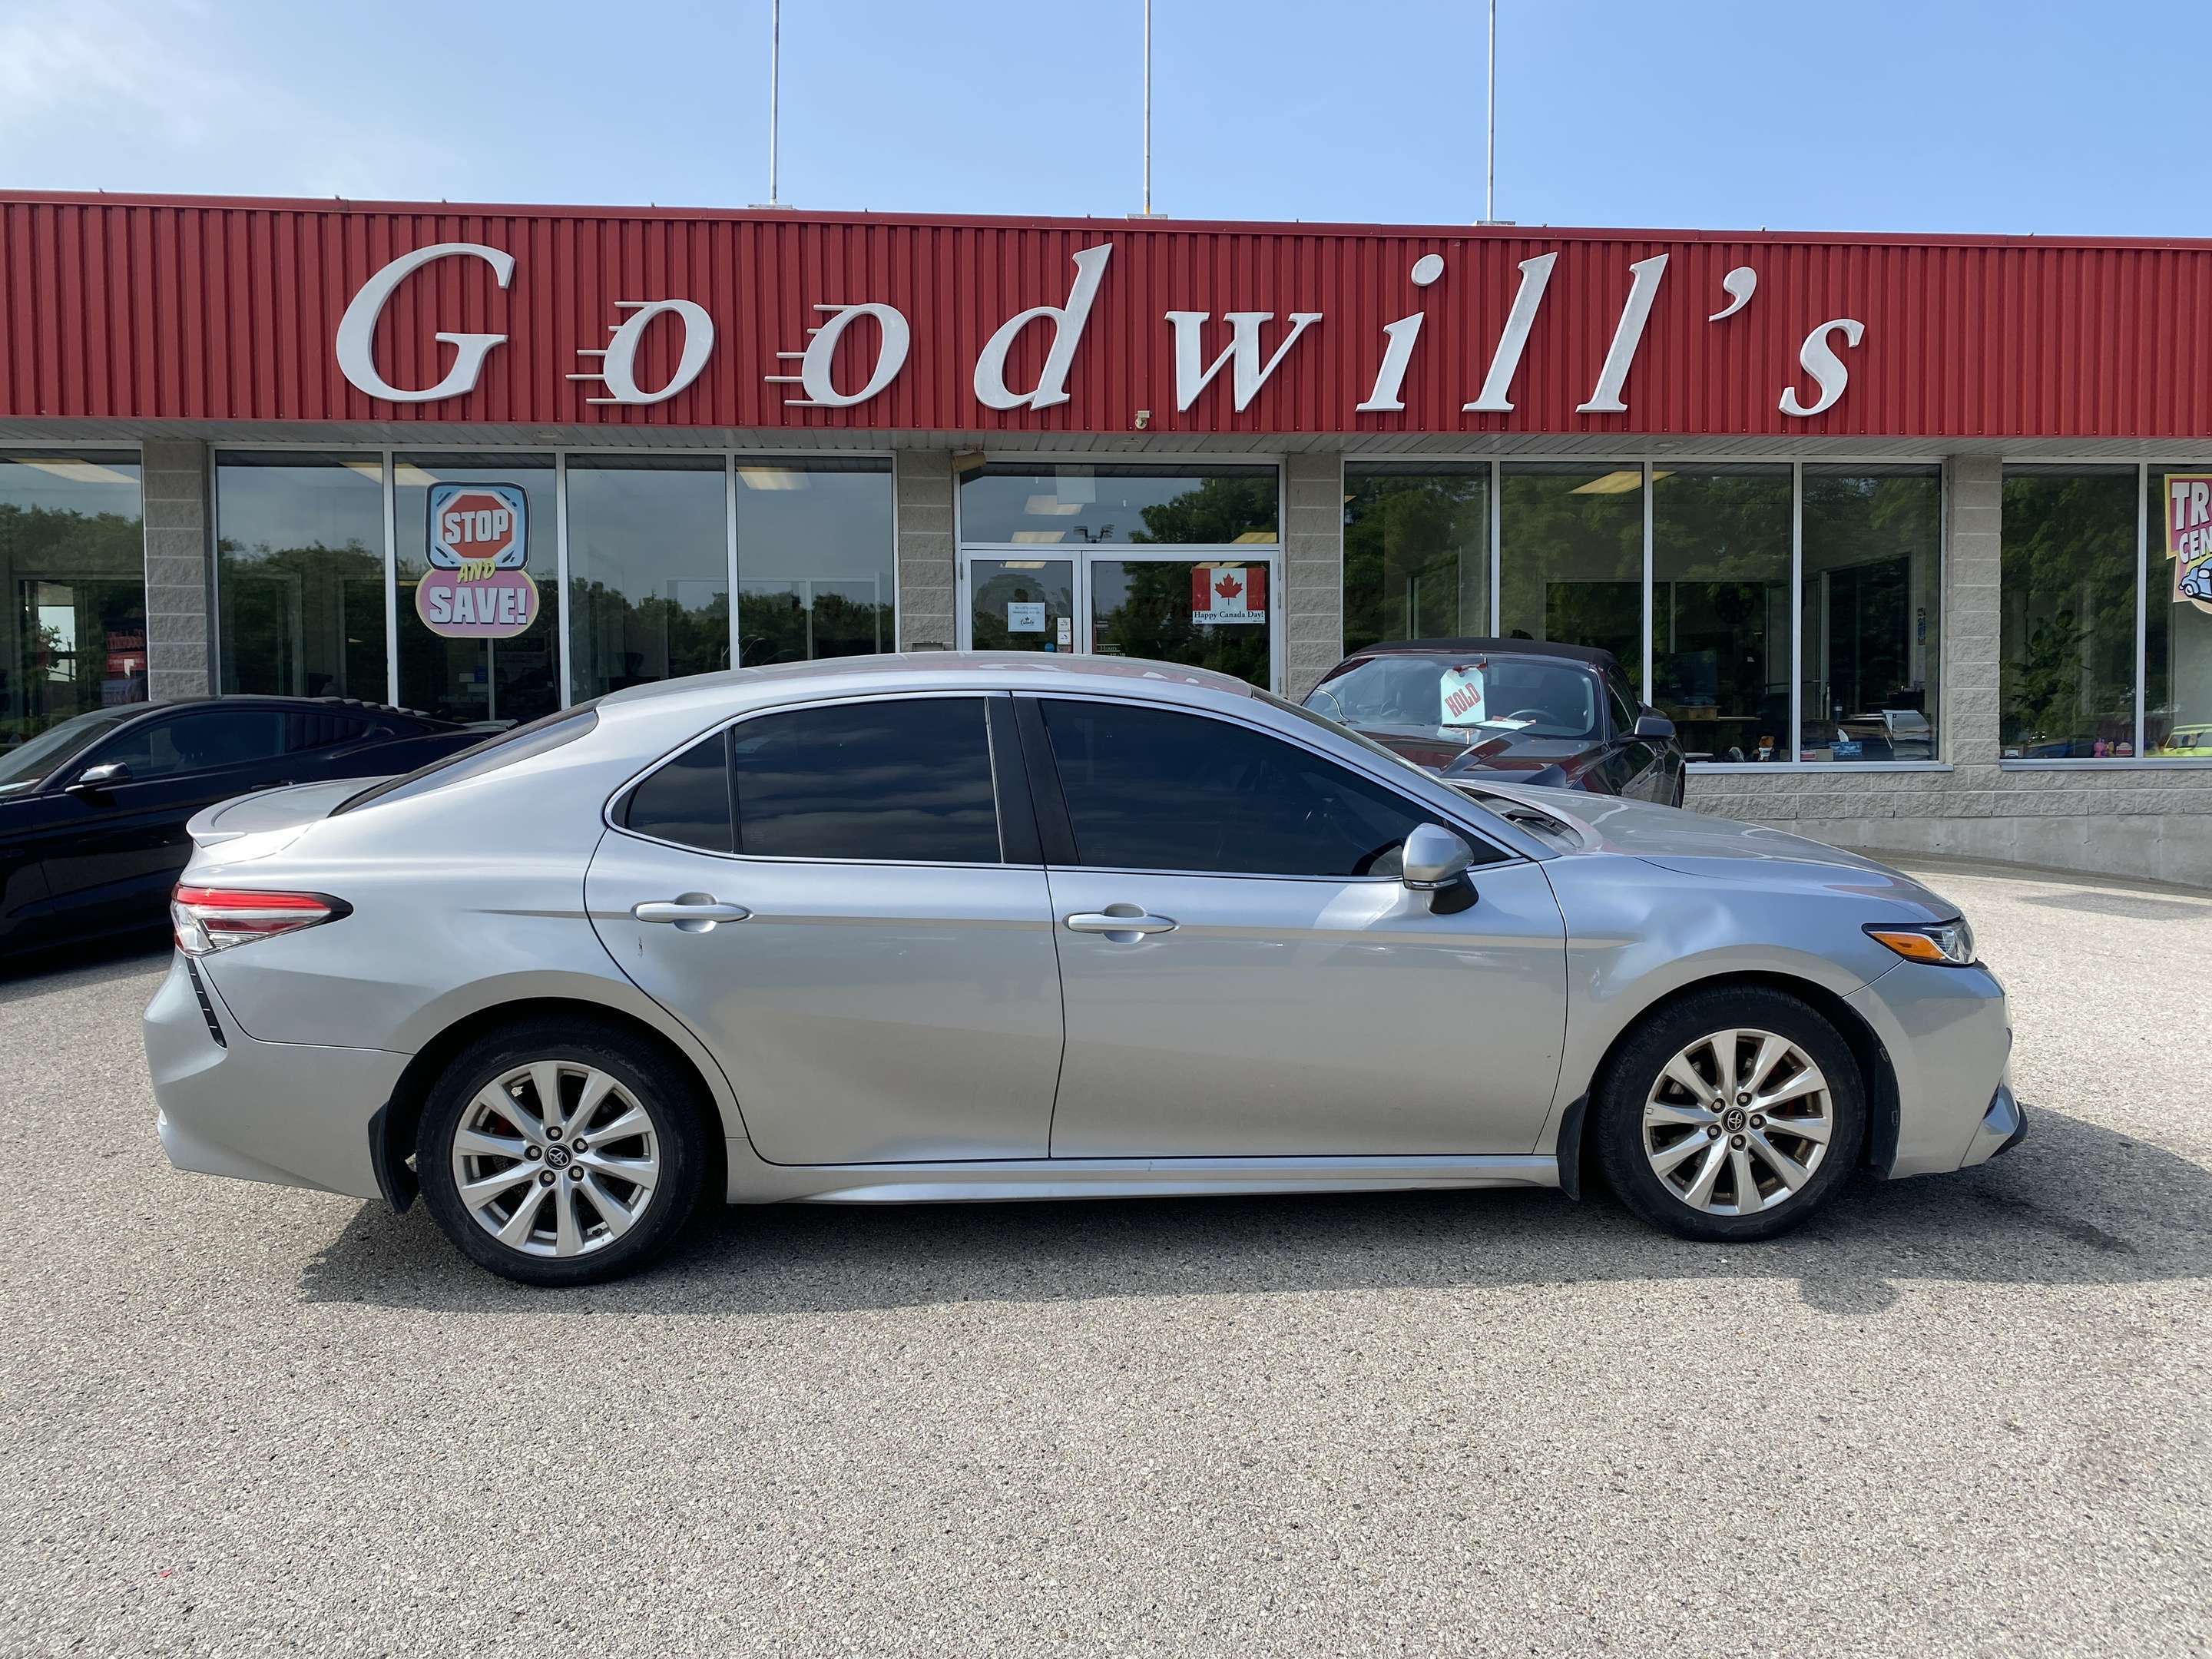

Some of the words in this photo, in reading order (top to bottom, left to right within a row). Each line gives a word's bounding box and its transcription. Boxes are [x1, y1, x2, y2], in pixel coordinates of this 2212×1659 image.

[336, 242, 1866, 417] Goodwill's
[2171, 482, 2212, 531] TR
[444, 508, 508, 545] STOP
[456, 558, 495, 584] AND
[429, 586, 528, 625] SAVE!
[1194, 611, 1217, 621] Happy
[1247, 611, 1264, 619] Day!
[1444, 682, 1482, 718] HOLD
